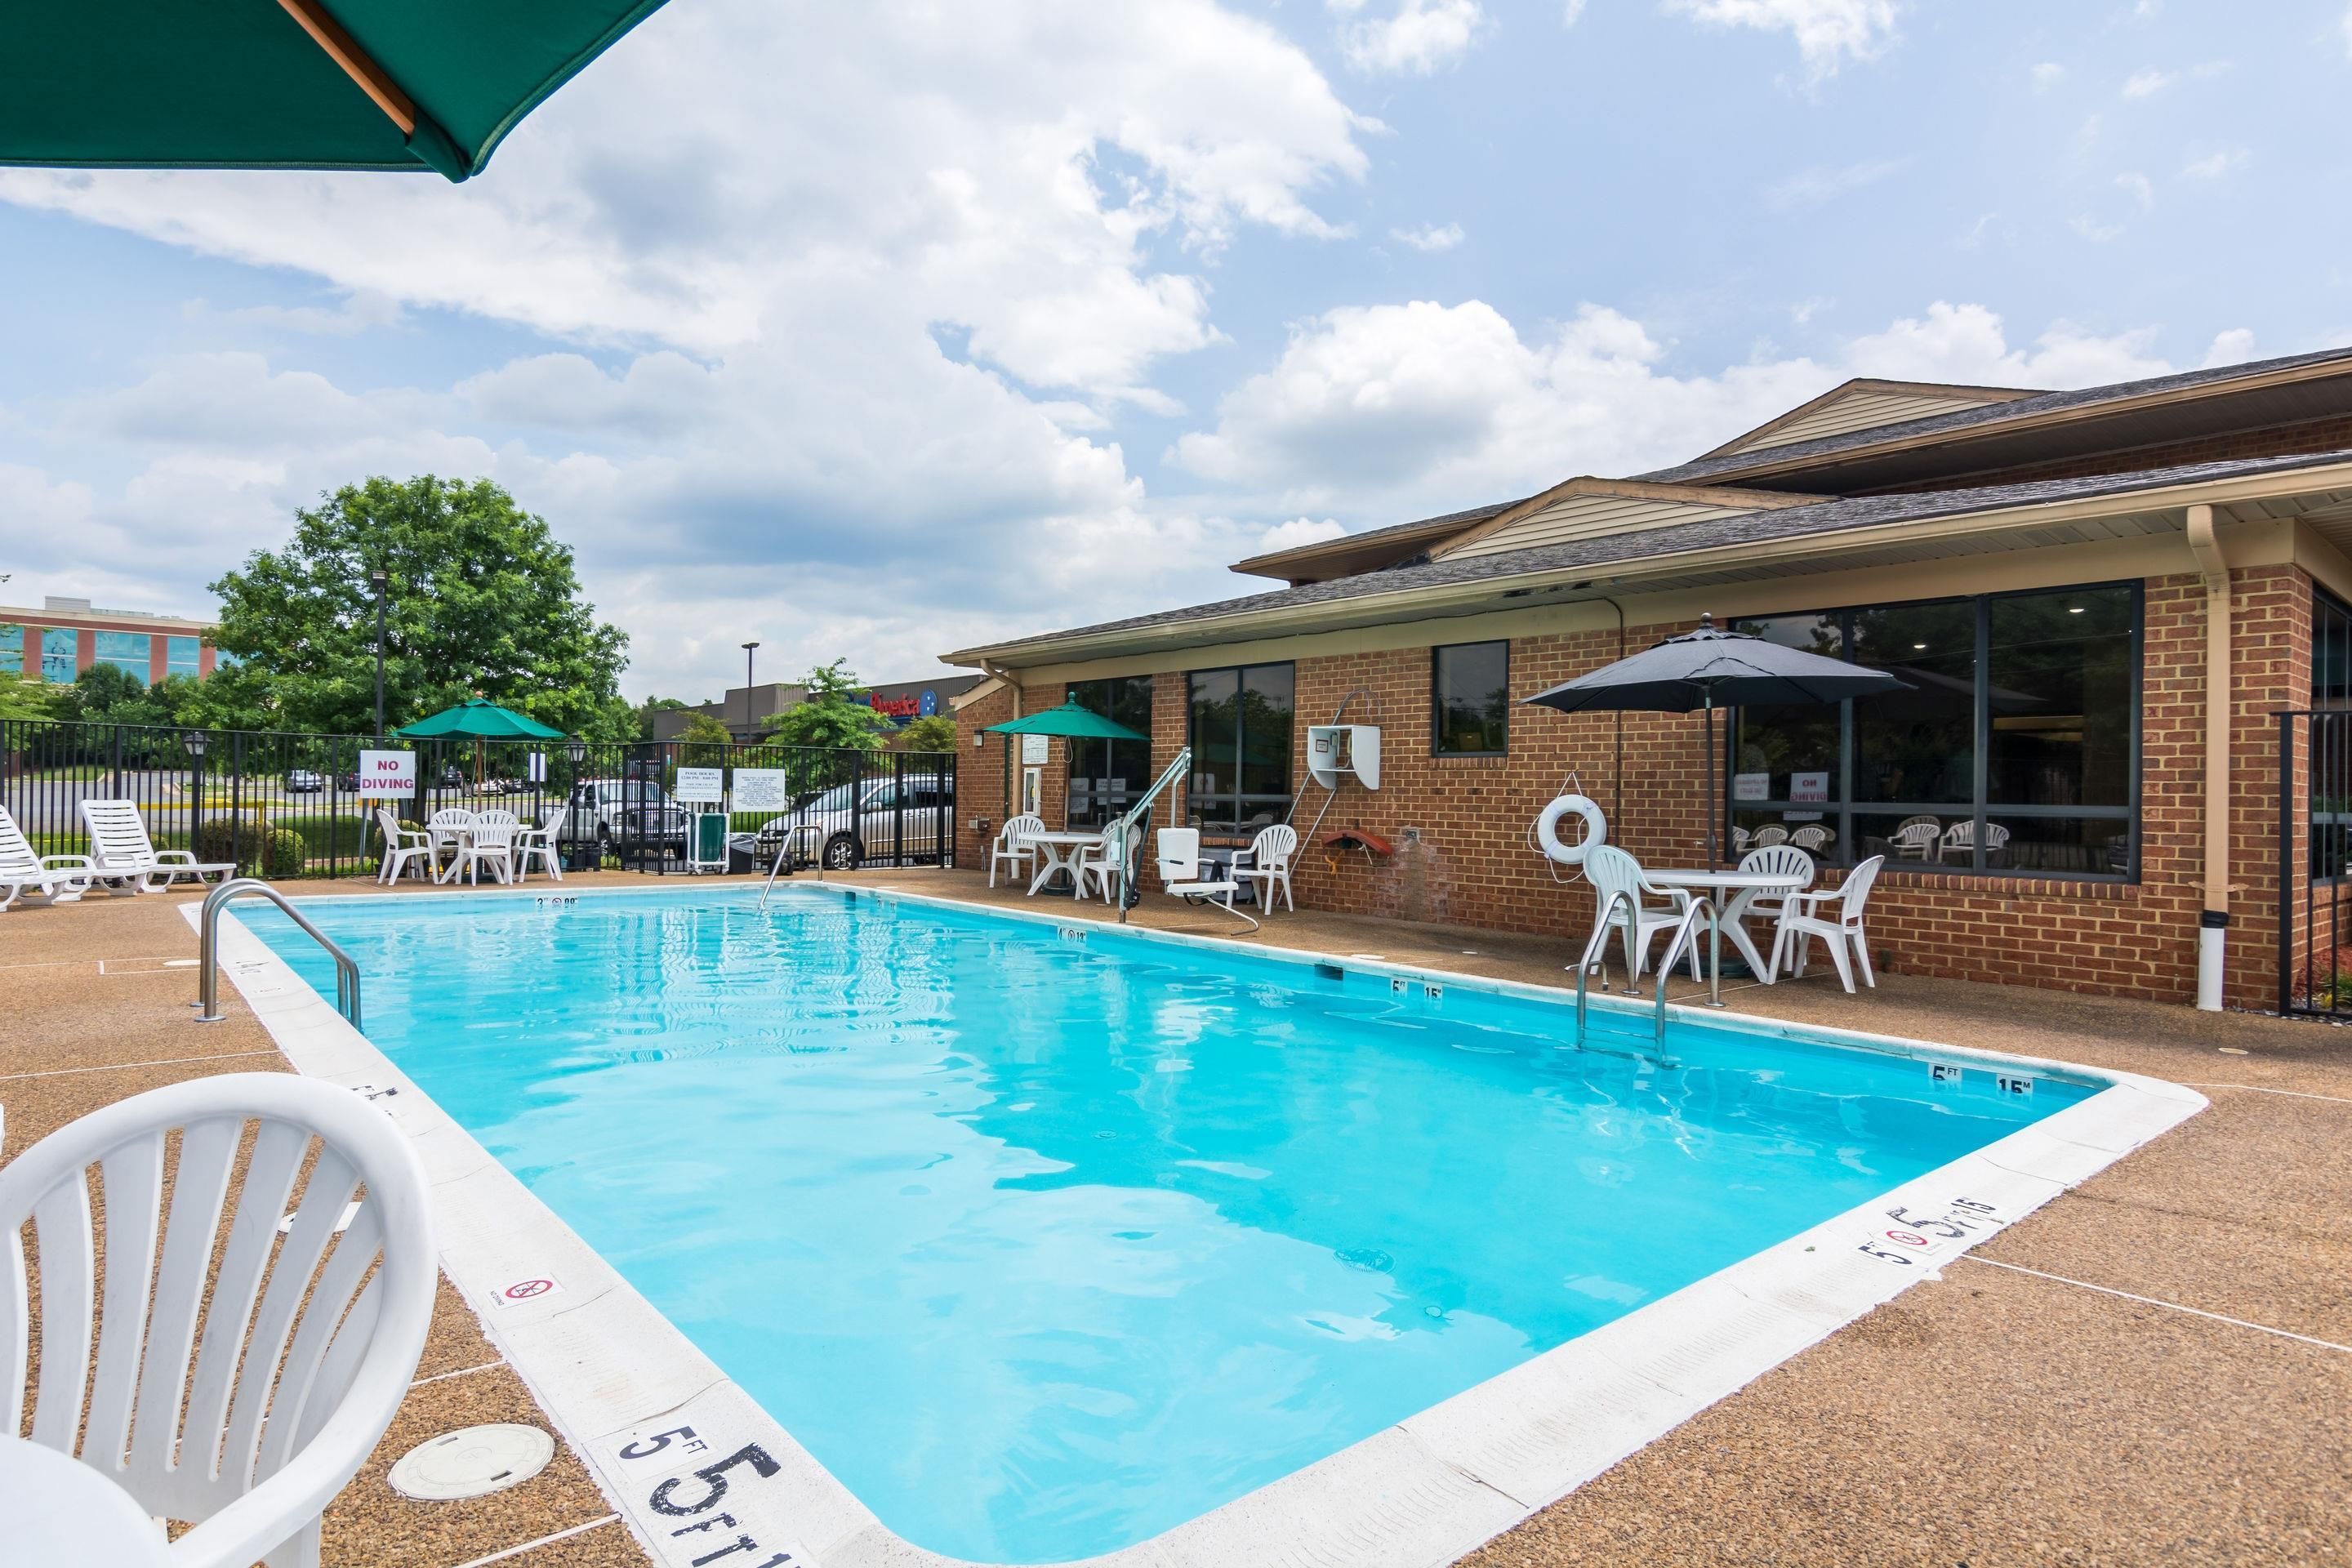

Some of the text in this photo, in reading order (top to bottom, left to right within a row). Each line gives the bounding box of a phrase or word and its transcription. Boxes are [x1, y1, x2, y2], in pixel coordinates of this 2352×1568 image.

[870, 692, 920, 715] America
[376, 760, 399, 770] NO
[362, 778, 414, 789] DIVING
